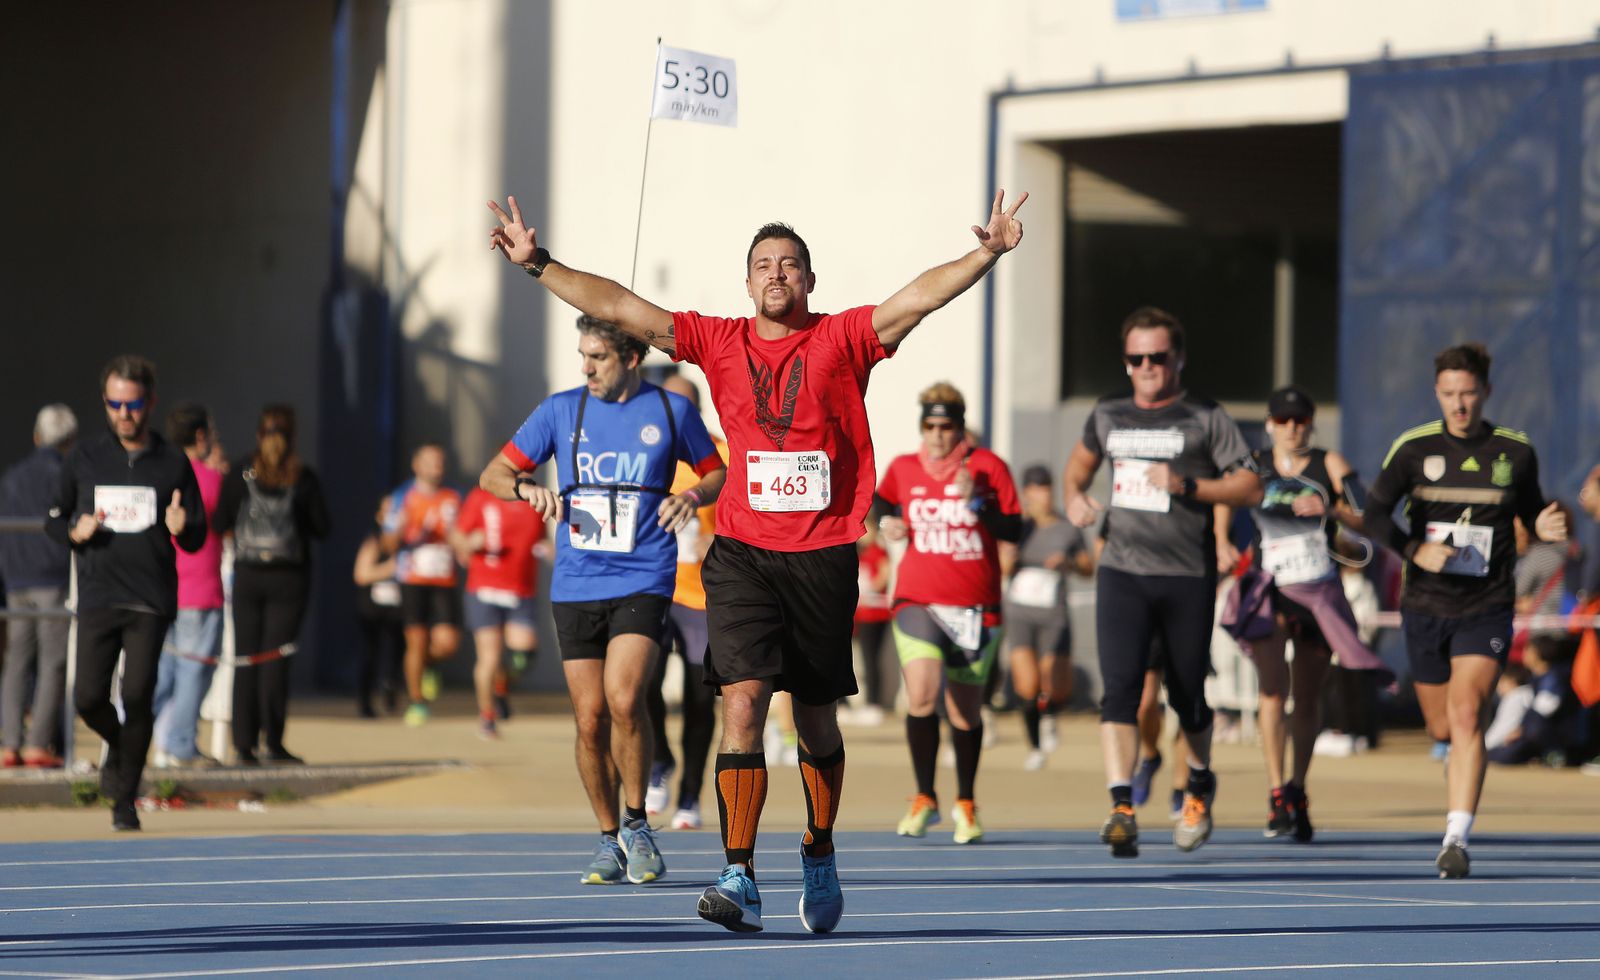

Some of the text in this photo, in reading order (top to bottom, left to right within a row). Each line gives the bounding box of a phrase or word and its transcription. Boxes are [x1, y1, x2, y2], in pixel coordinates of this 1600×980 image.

[662, 61, 728, 98] 5:30
[671, 101, 719, 117] min/km
[577, 451, 648, 483] RCM
[798, 464, 819, 472] CAUSA
[770, 475, 807, 496] 463
[914, 528, 983, 554] CAUSA
